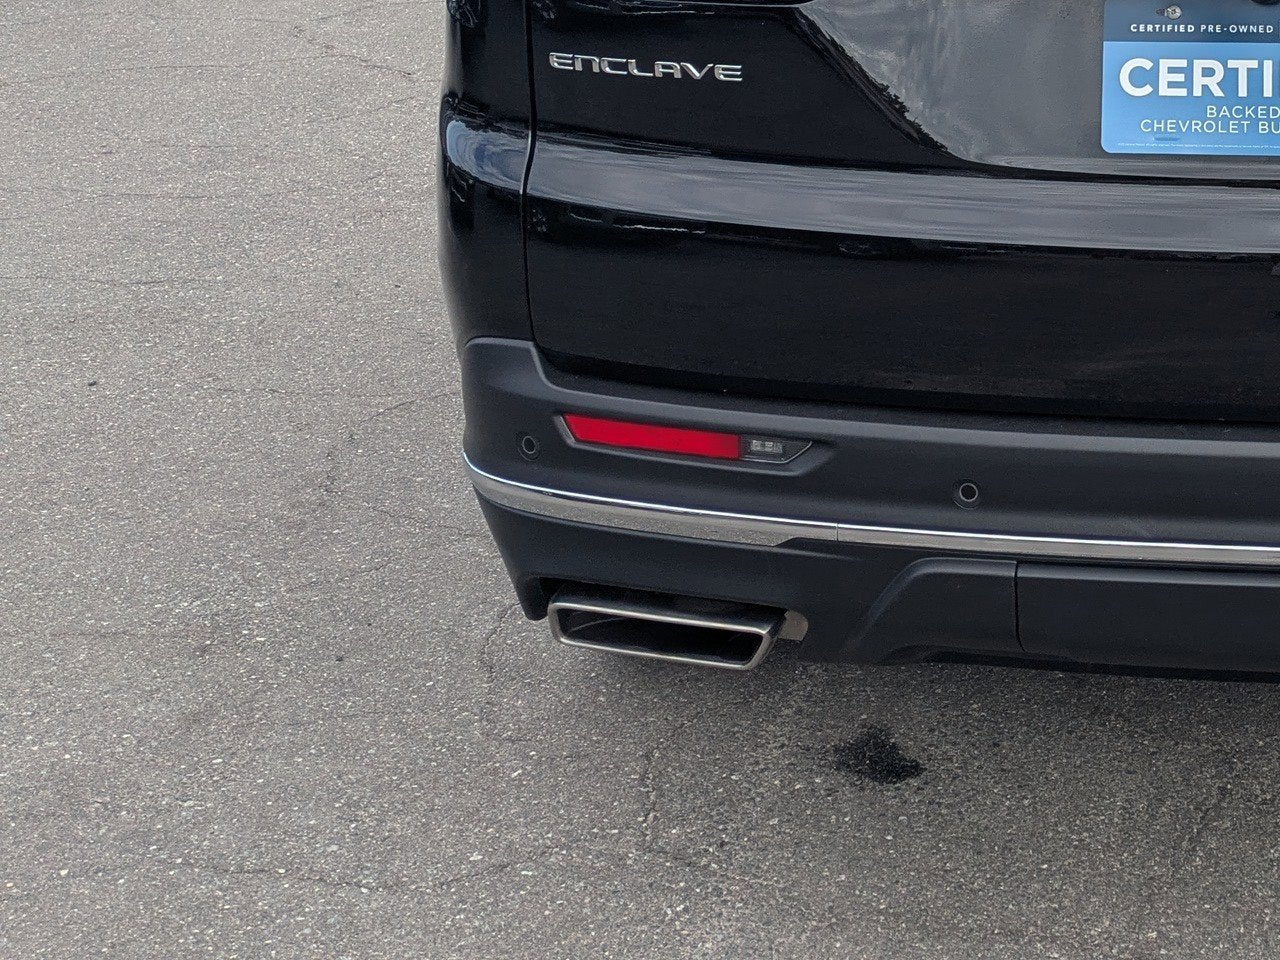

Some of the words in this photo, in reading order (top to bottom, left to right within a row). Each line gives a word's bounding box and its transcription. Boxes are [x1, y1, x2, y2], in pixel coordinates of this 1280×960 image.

[1130, 23, 1195, 33] CERTIFIED
[1200, 24, 1274, 34] PRE-OWNED
[549, 52, 743, 82] ENCLAVE
[1206, 106, 1280, 119] BACKED
[1140, 120, 1251, 134] CHEVROLET
